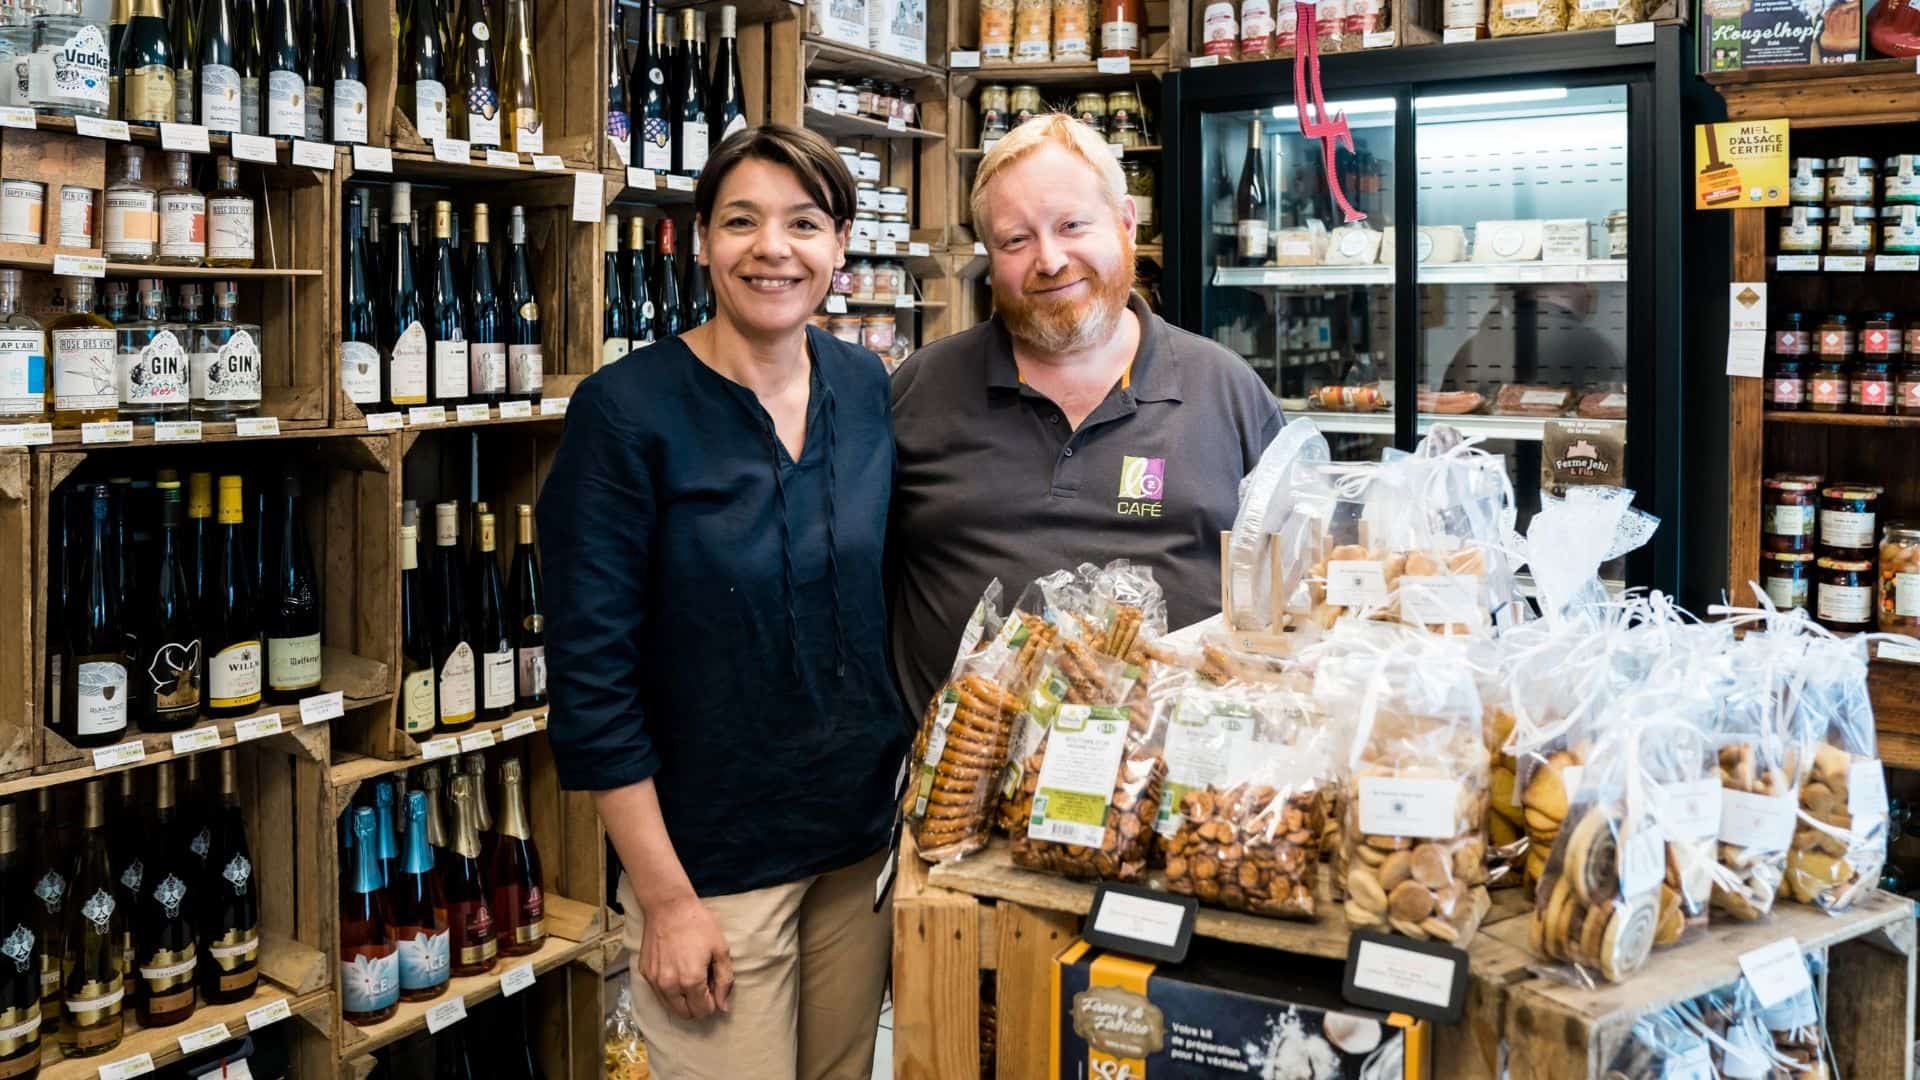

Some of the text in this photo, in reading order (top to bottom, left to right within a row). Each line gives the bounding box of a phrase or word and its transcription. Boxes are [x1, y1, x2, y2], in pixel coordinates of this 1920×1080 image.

[1711, 20, 1823, 45] Kougelhopf
[1740, 126, 1769, 135] MIEL
[1729, 143, 1784, 155] CERTIFIÉ
[151, 357, 177, 375] GIN
[228, 355, 252, 373] GIN
[1555, 459, 1587, 471] Ferme
[1117, 501, 1163, 517] CAFÉ
[1172, 1022, 1213, 1041] Votre kit
[1171, 1035, 1241, 1058] de préparation
[1171, 1048, 1249, 1073] pour le véritable
